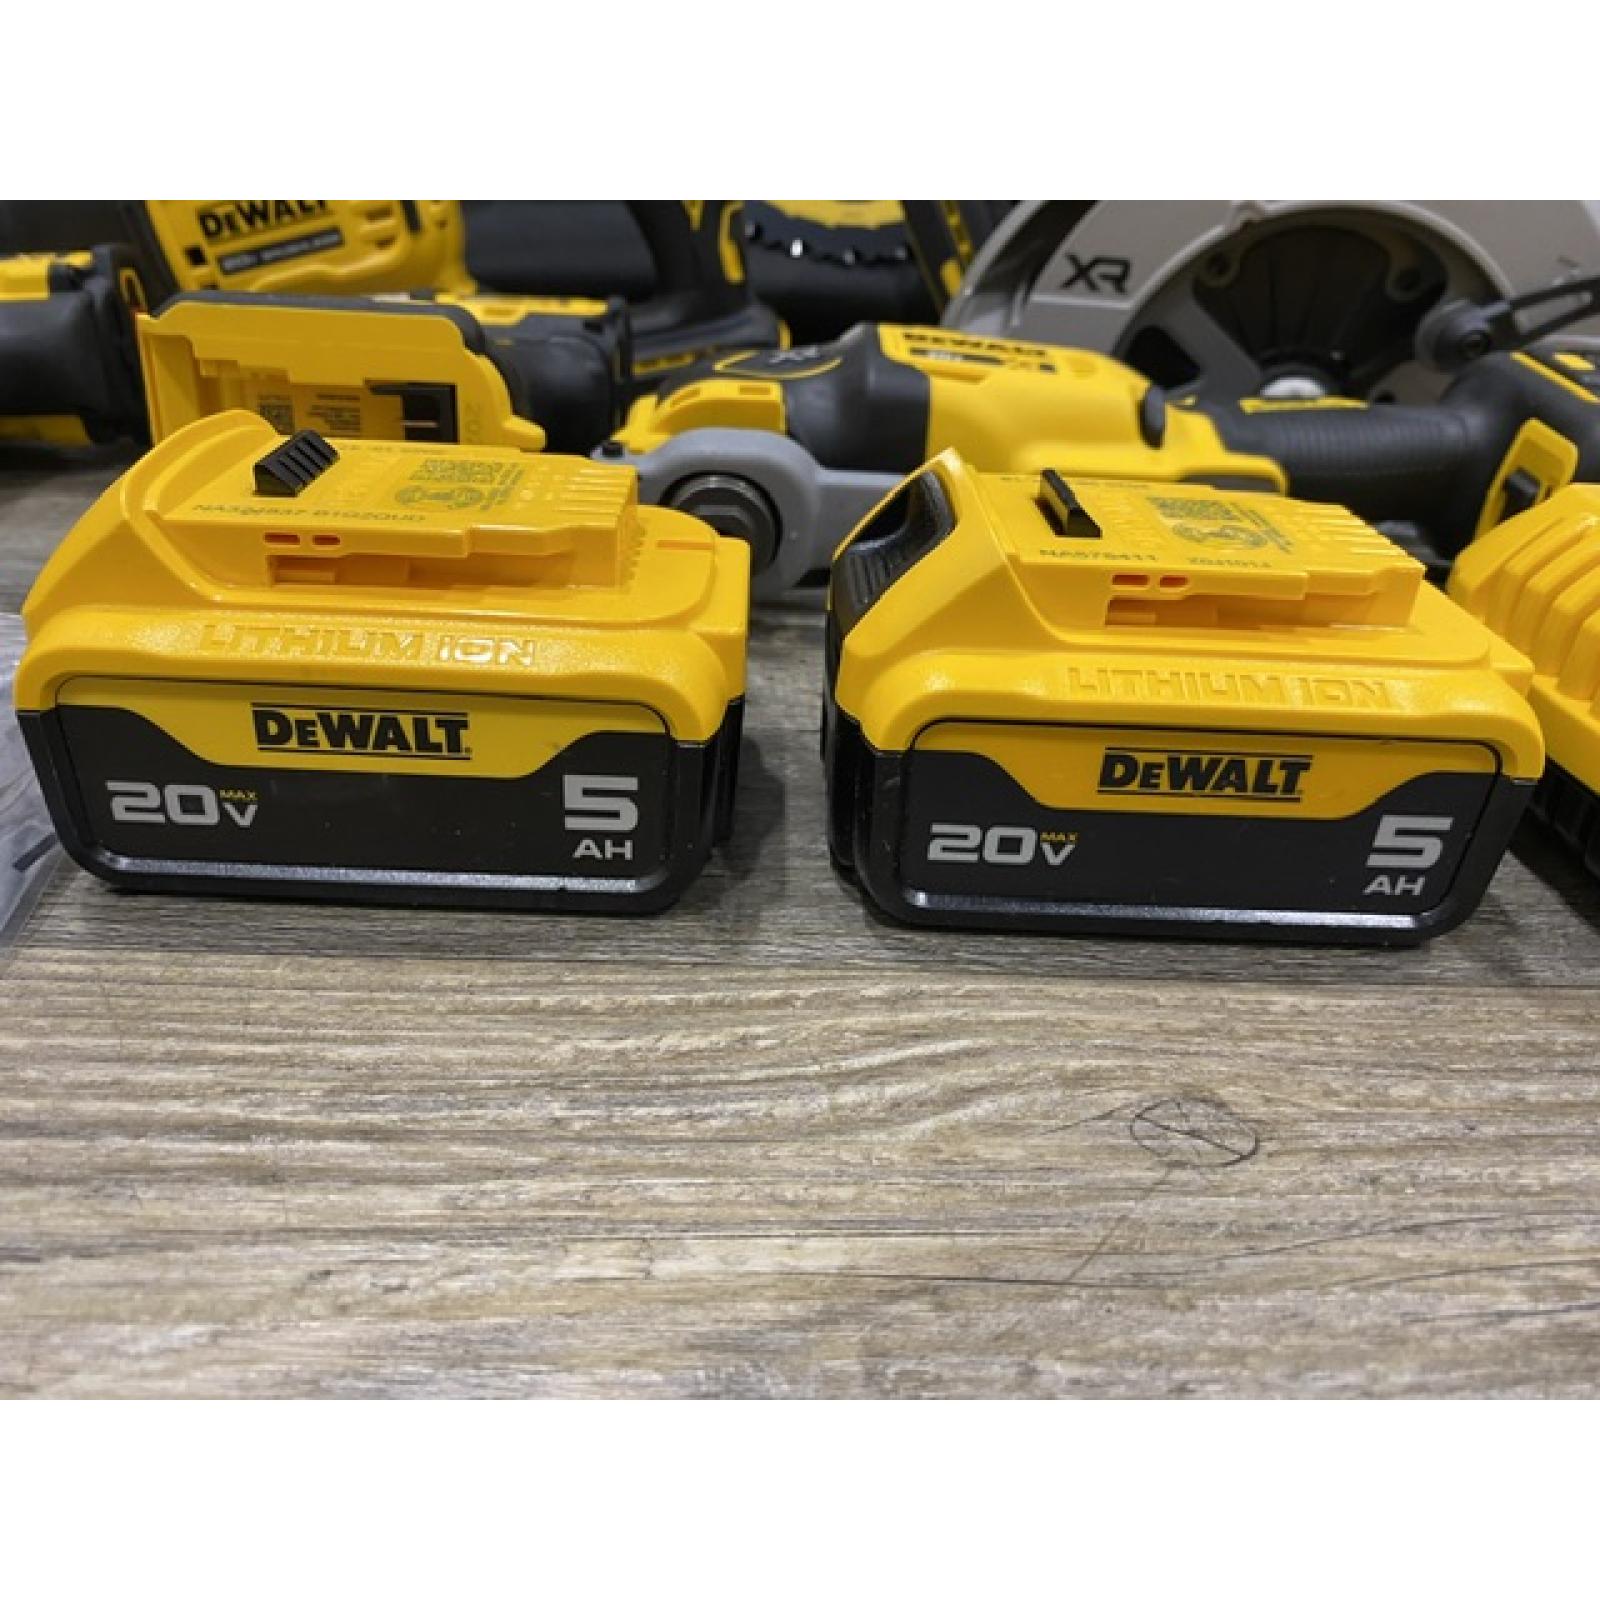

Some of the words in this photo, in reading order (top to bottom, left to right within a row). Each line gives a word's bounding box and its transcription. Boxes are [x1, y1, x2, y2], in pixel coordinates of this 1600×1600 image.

[1062, 253, 1130, 294] XR
[200, 623, 425, 662] LITHIUM
[437, 635, 536, 667] ION
[1067, 667, 1287, 704] LITHIUM
[1297, 677, 1391, 709] ION
[251, 708, 470, 754] DEWALT
[1098, 753, 1311, 796] DEWALT
[562, 773, 639, 831] 5
[572, 838, 634, 861] AH
[1365, 813, 1455, 869] 5
[1361, 873, 1426, 896] AH
